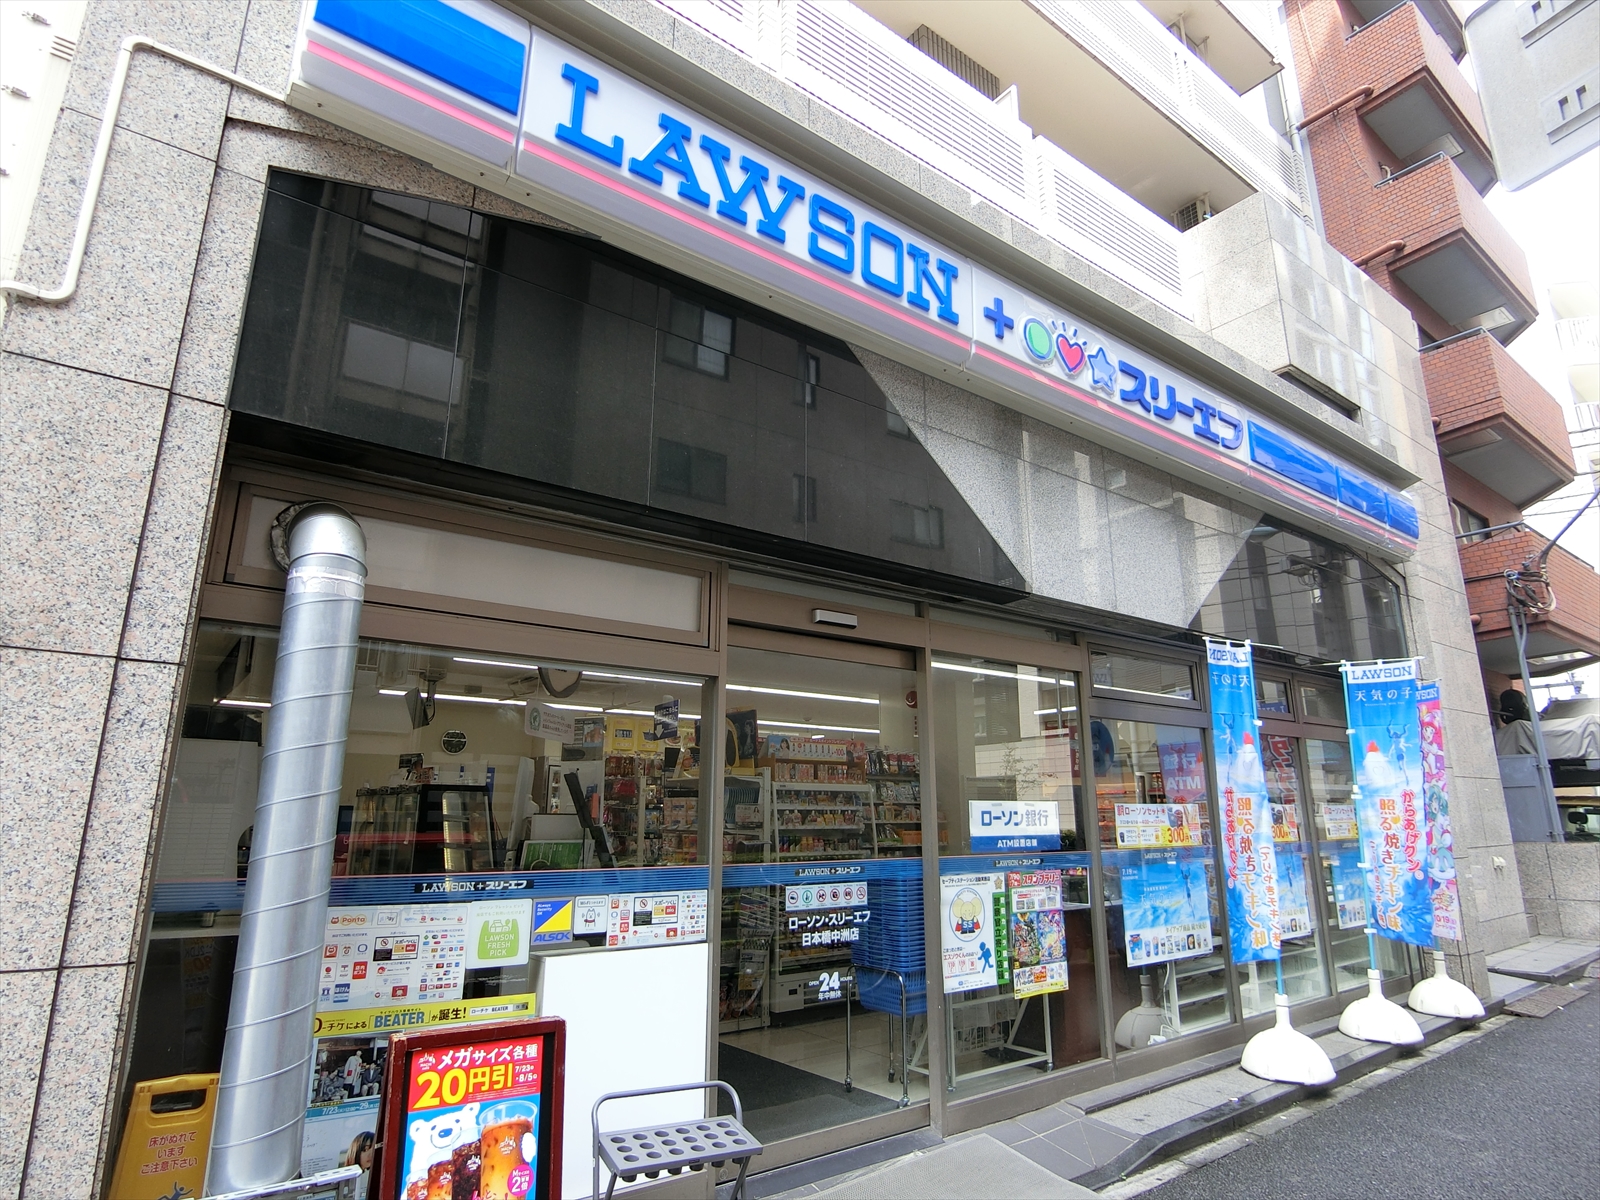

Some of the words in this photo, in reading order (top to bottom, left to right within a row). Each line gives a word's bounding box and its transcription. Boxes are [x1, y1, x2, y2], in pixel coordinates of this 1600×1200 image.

[554, 62, 960, 326] LAWSON
[1118, 359, 1244, 450] スリーエフ
[1352, 665, 1412, 680] LAWSON
[1355, 686, 1413, 702] 天気の子
[1166, 775, 1201, 791] ATM
[981, 809, 1049, 827] ローソン銀行
[1402, 790, 1420, 873] からあげクン
[798, 868, 830, 876] LAWSON
[836, 866, 861, 875] スリーエフ
[1379, 798, 1402, 930] 照る焼きチキン味
[486, 880, 528, 890] スリーエフ
[788, 910, 871, 930] ローソン・スリーエフ
[962, 920, 973, 929] SS
[484, 934, 514, 942] LAWSON
[488, 941, 511, 949] FRESH
[533, 932, 571, 943] ALSOK
[802, 928, 860, 947] 日本橋中洲店
[490, 948, 507, 956] PICK
[819, 972, 840, 992] 24
[438, 1044, 538, 1070] メガサイズ各種
[413, 1063, 513, 1109] 20円引
[148, 1131, 197, 1148] 床がぬれて
[158, 1146, 186, 1158] います
[141, 1158, 198, 1174] ご注意下さい
